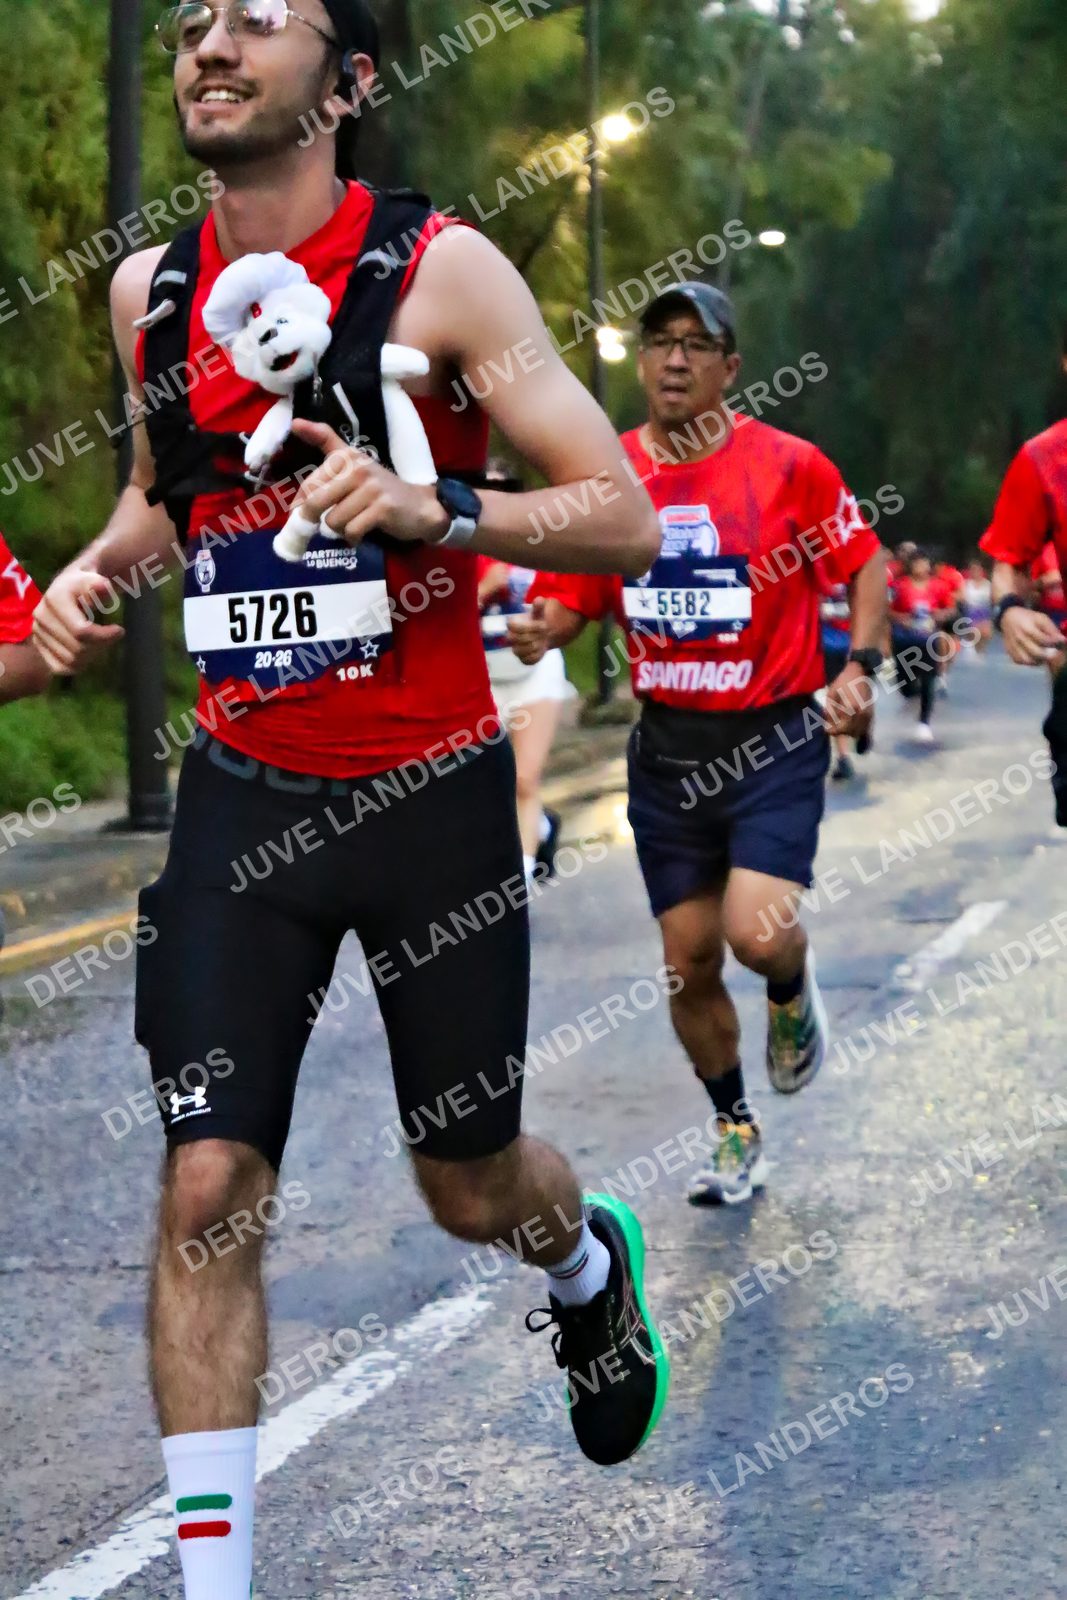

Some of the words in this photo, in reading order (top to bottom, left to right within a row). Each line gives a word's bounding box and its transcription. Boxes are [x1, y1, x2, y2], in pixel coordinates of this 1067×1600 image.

[302, 548, 357, 560] PARTIMOS
[657, 590, 711, 616] 5582
[228, 590, 318, 643] 5726
[336, 664, 374, 681] 10K
[637, 659, 753, 692] SANTIAGO
